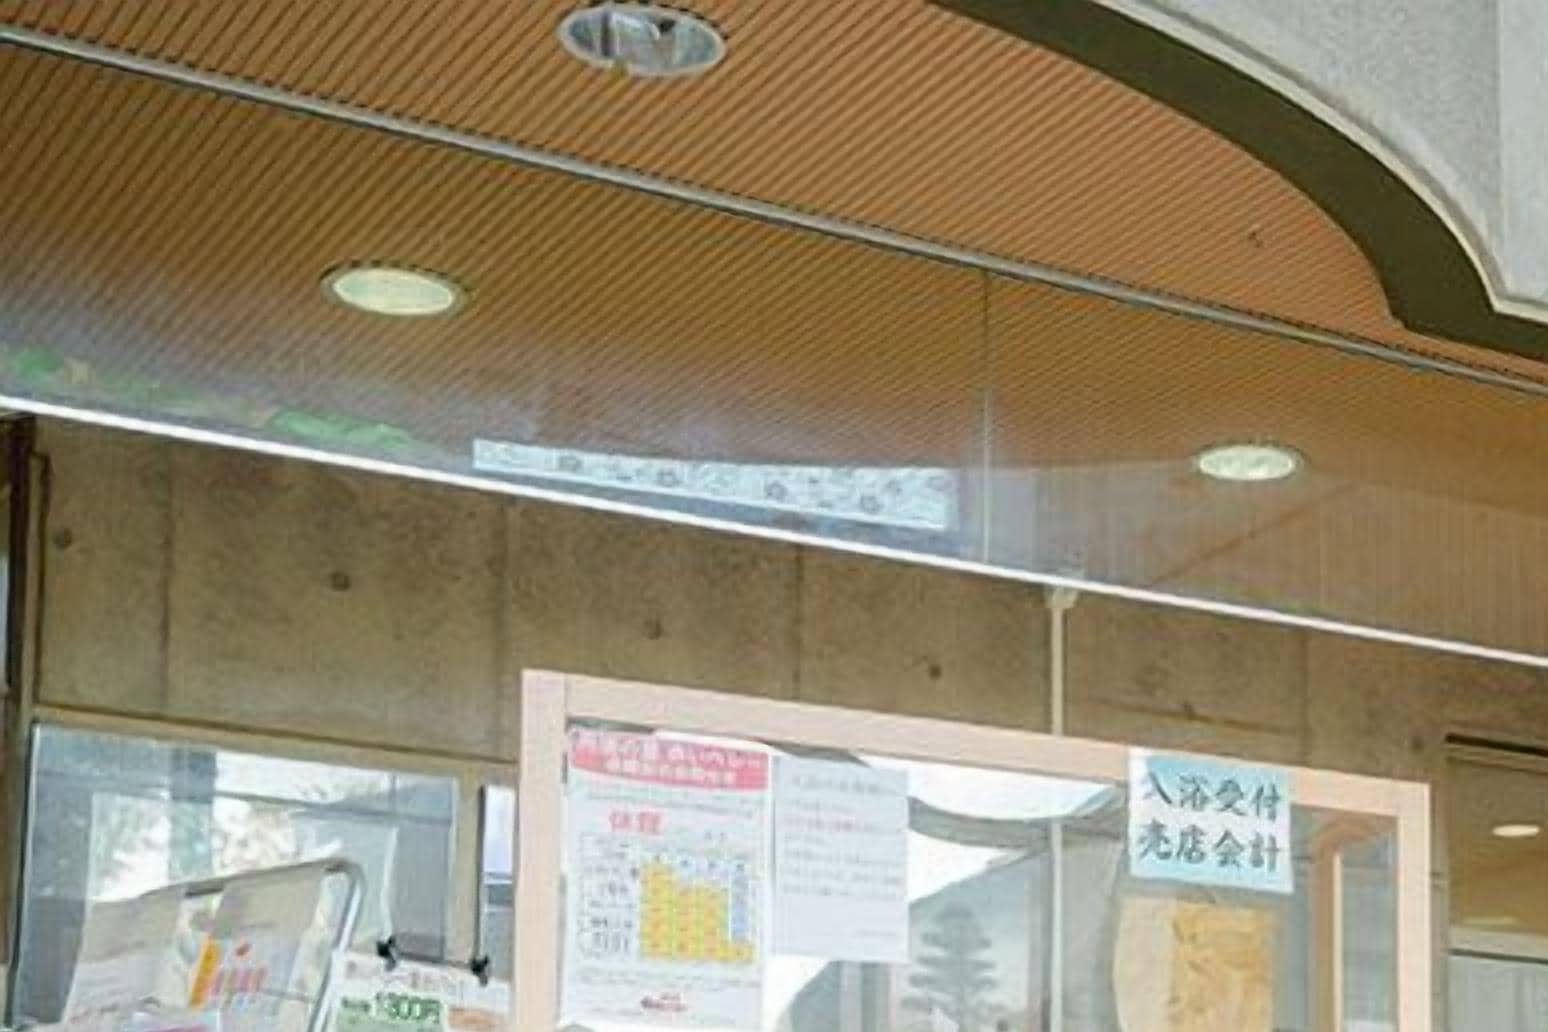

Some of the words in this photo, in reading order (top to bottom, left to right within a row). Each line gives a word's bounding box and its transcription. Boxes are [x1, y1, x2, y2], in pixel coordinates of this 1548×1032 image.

[1141, 771, 1281, 822] 入浴受付
[1138, 817, 1280, 873] 売店会計
